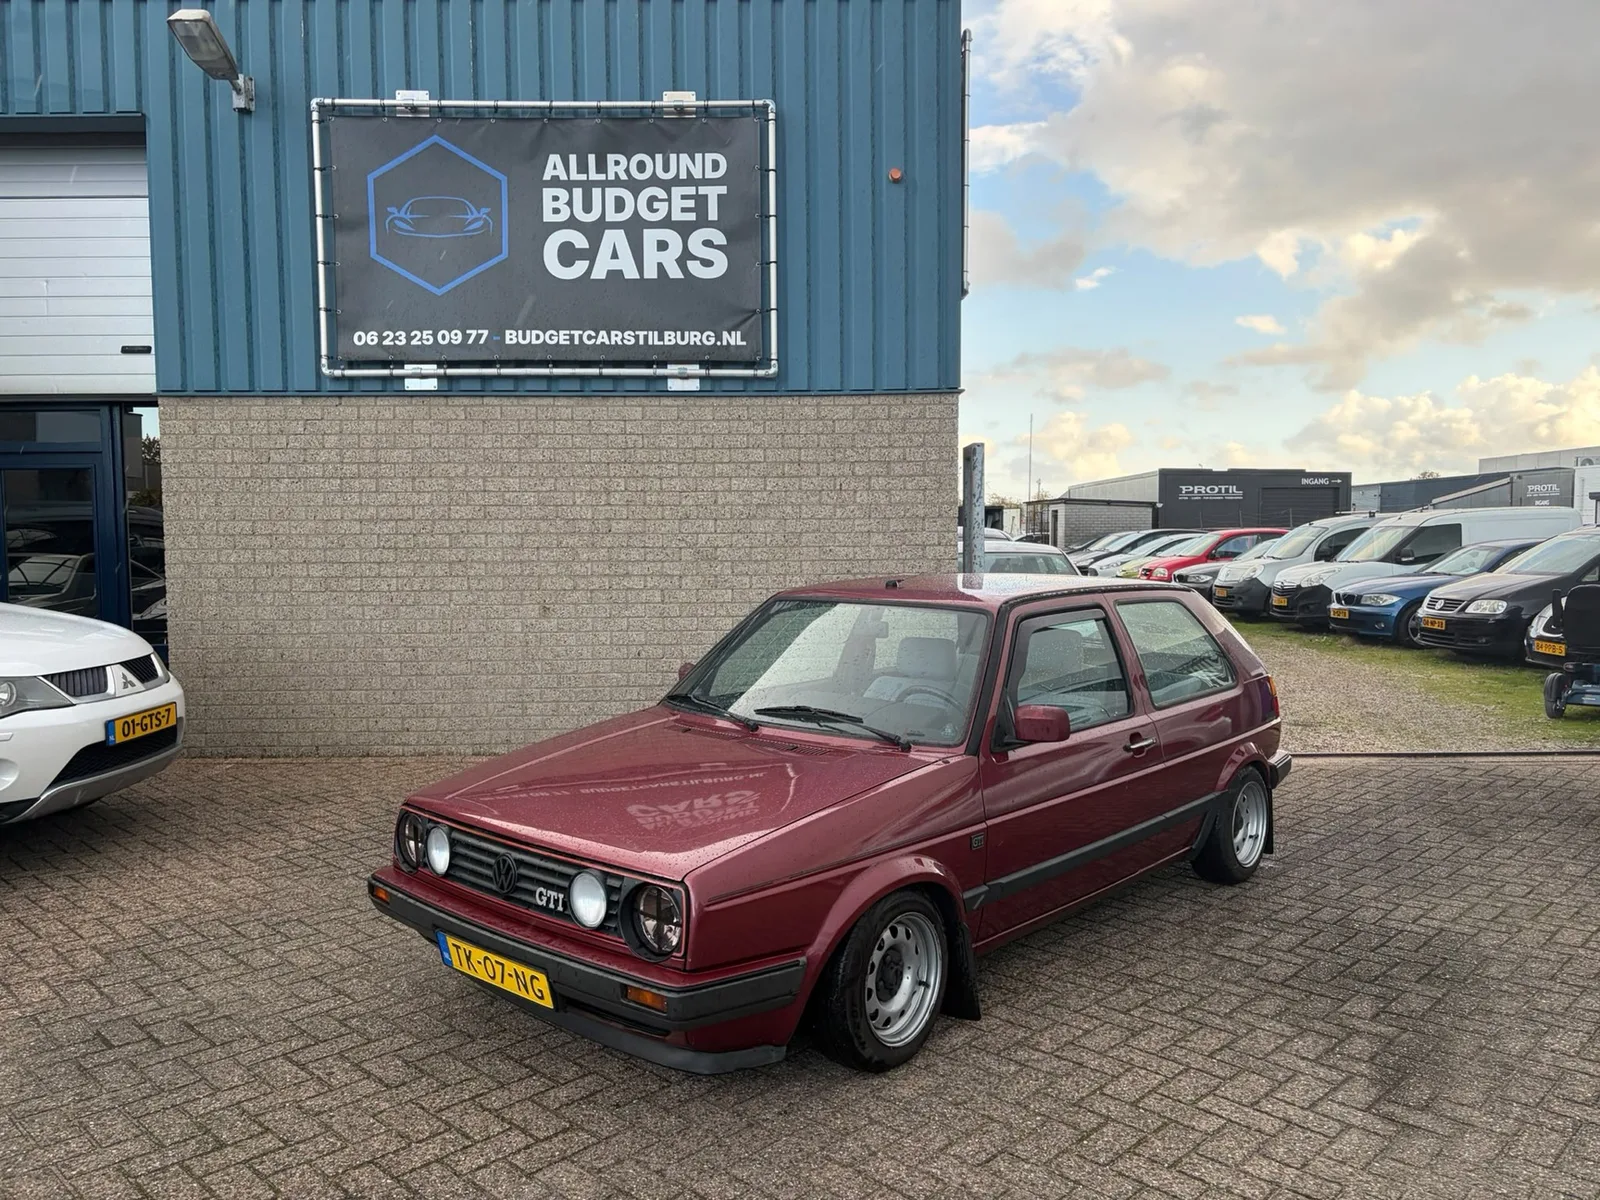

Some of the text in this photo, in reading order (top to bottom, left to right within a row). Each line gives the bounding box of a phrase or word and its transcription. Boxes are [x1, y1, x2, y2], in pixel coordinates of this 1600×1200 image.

[543, 153, 727, 181] ALLROUND
[543, 185, 727, 223] BUDGET
[543, 228, 729, 280] CARS
[353, 331, 379, 347] 06
[382, 330, 407, 346] 23
[410, 330, 434, 346] 25
[436, 330, 462, 346] 09
[464, 329, 489, 345] 77
[505, 329, 747, 347] BUDGETCARSTILBURG.NL
[1179, 485, 1244, 495] PROTIL
[1301, 477, 1330, 486] INGANG
[1526, 483, 1561, 493] PROTIL
[121, 707, 171, 738] 01-GTS-7
[535, 887, 565, 913] GTI
[451, 942, 546, 1001] TK-07-NG
